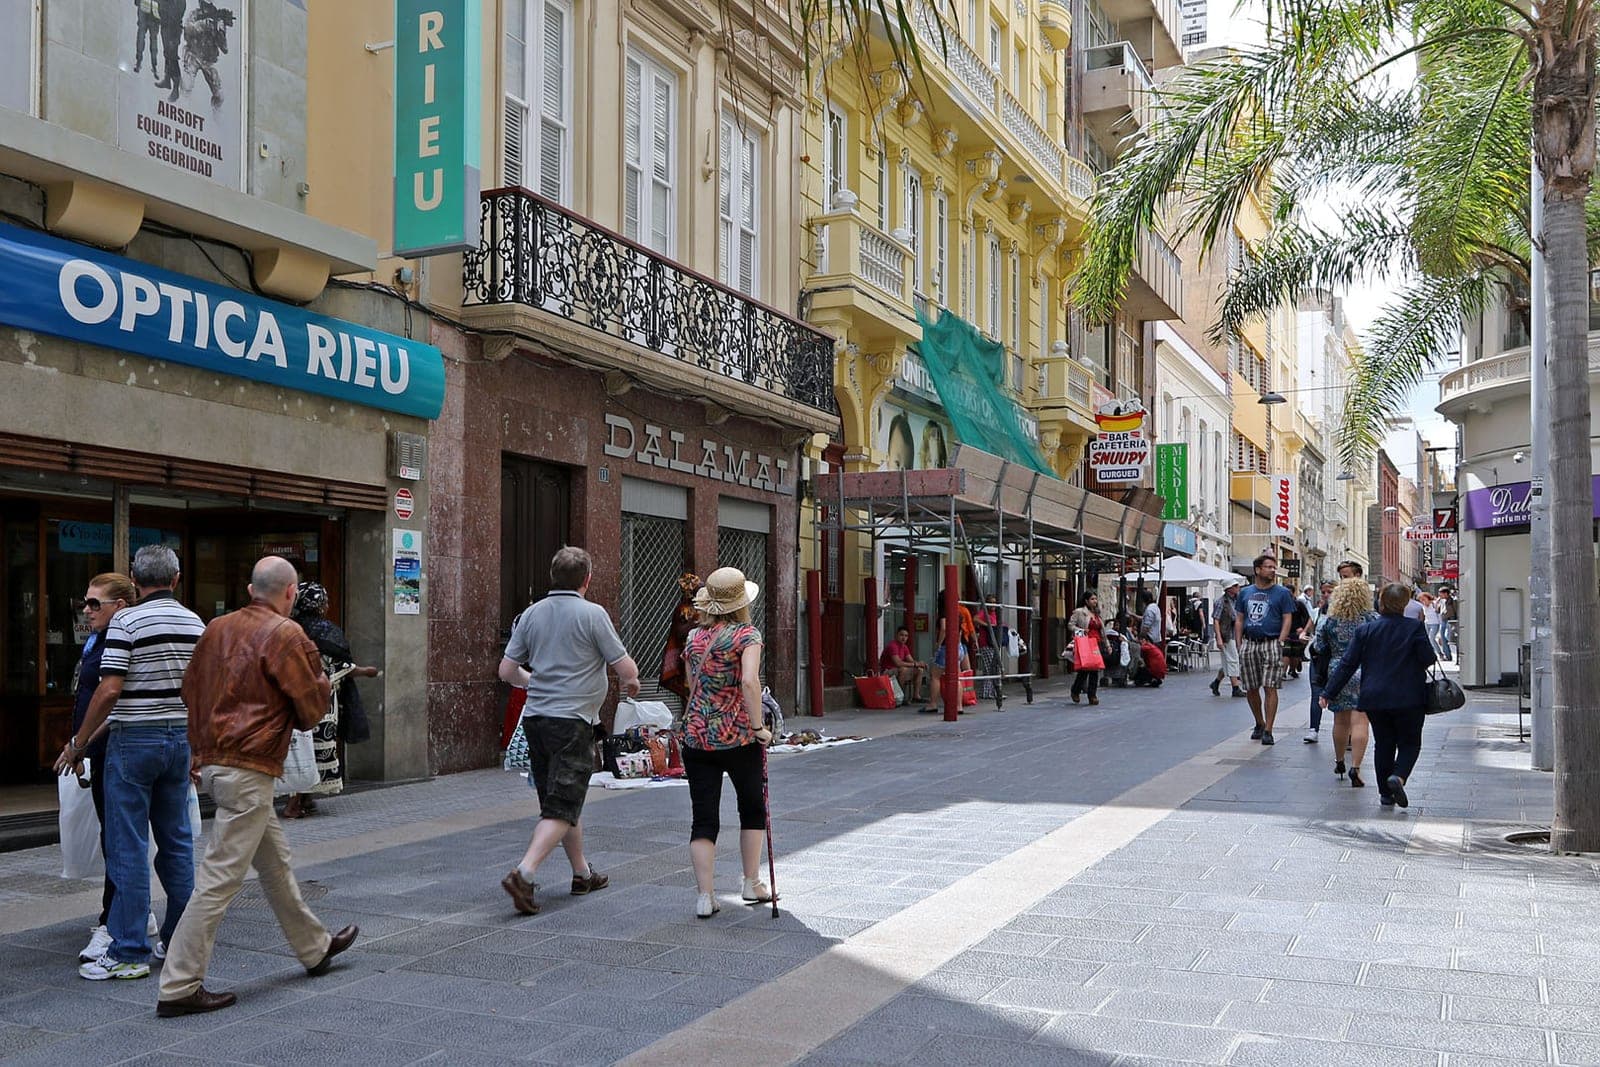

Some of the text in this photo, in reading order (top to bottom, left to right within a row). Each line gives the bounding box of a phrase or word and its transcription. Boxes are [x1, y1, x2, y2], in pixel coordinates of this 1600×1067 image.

[157, 99, 206, 132] AIRSOFT
[413, 10, 446, 212] RIEU
[136, 113, 224, 161] EQUIP. POLICIAL
[147, 140, 213, 178] SEGURIDAD
[58, 258, 410, 395] OPTICA RIEU
[1091, 440, 1147, 451] CAFETERIA
[1108, 432, 1129, 441] BAR
[1091, 451, 1148, 466] SNUUPY
[1100, 469, 1139, 479] BURGUER
[1172, 445, 1183, 520] MUNDIAL
[1275, 477, 1291, 533] Bata
[1437, 509, 1452, 528] 7
[1252, 602, 1264, 614] 76
